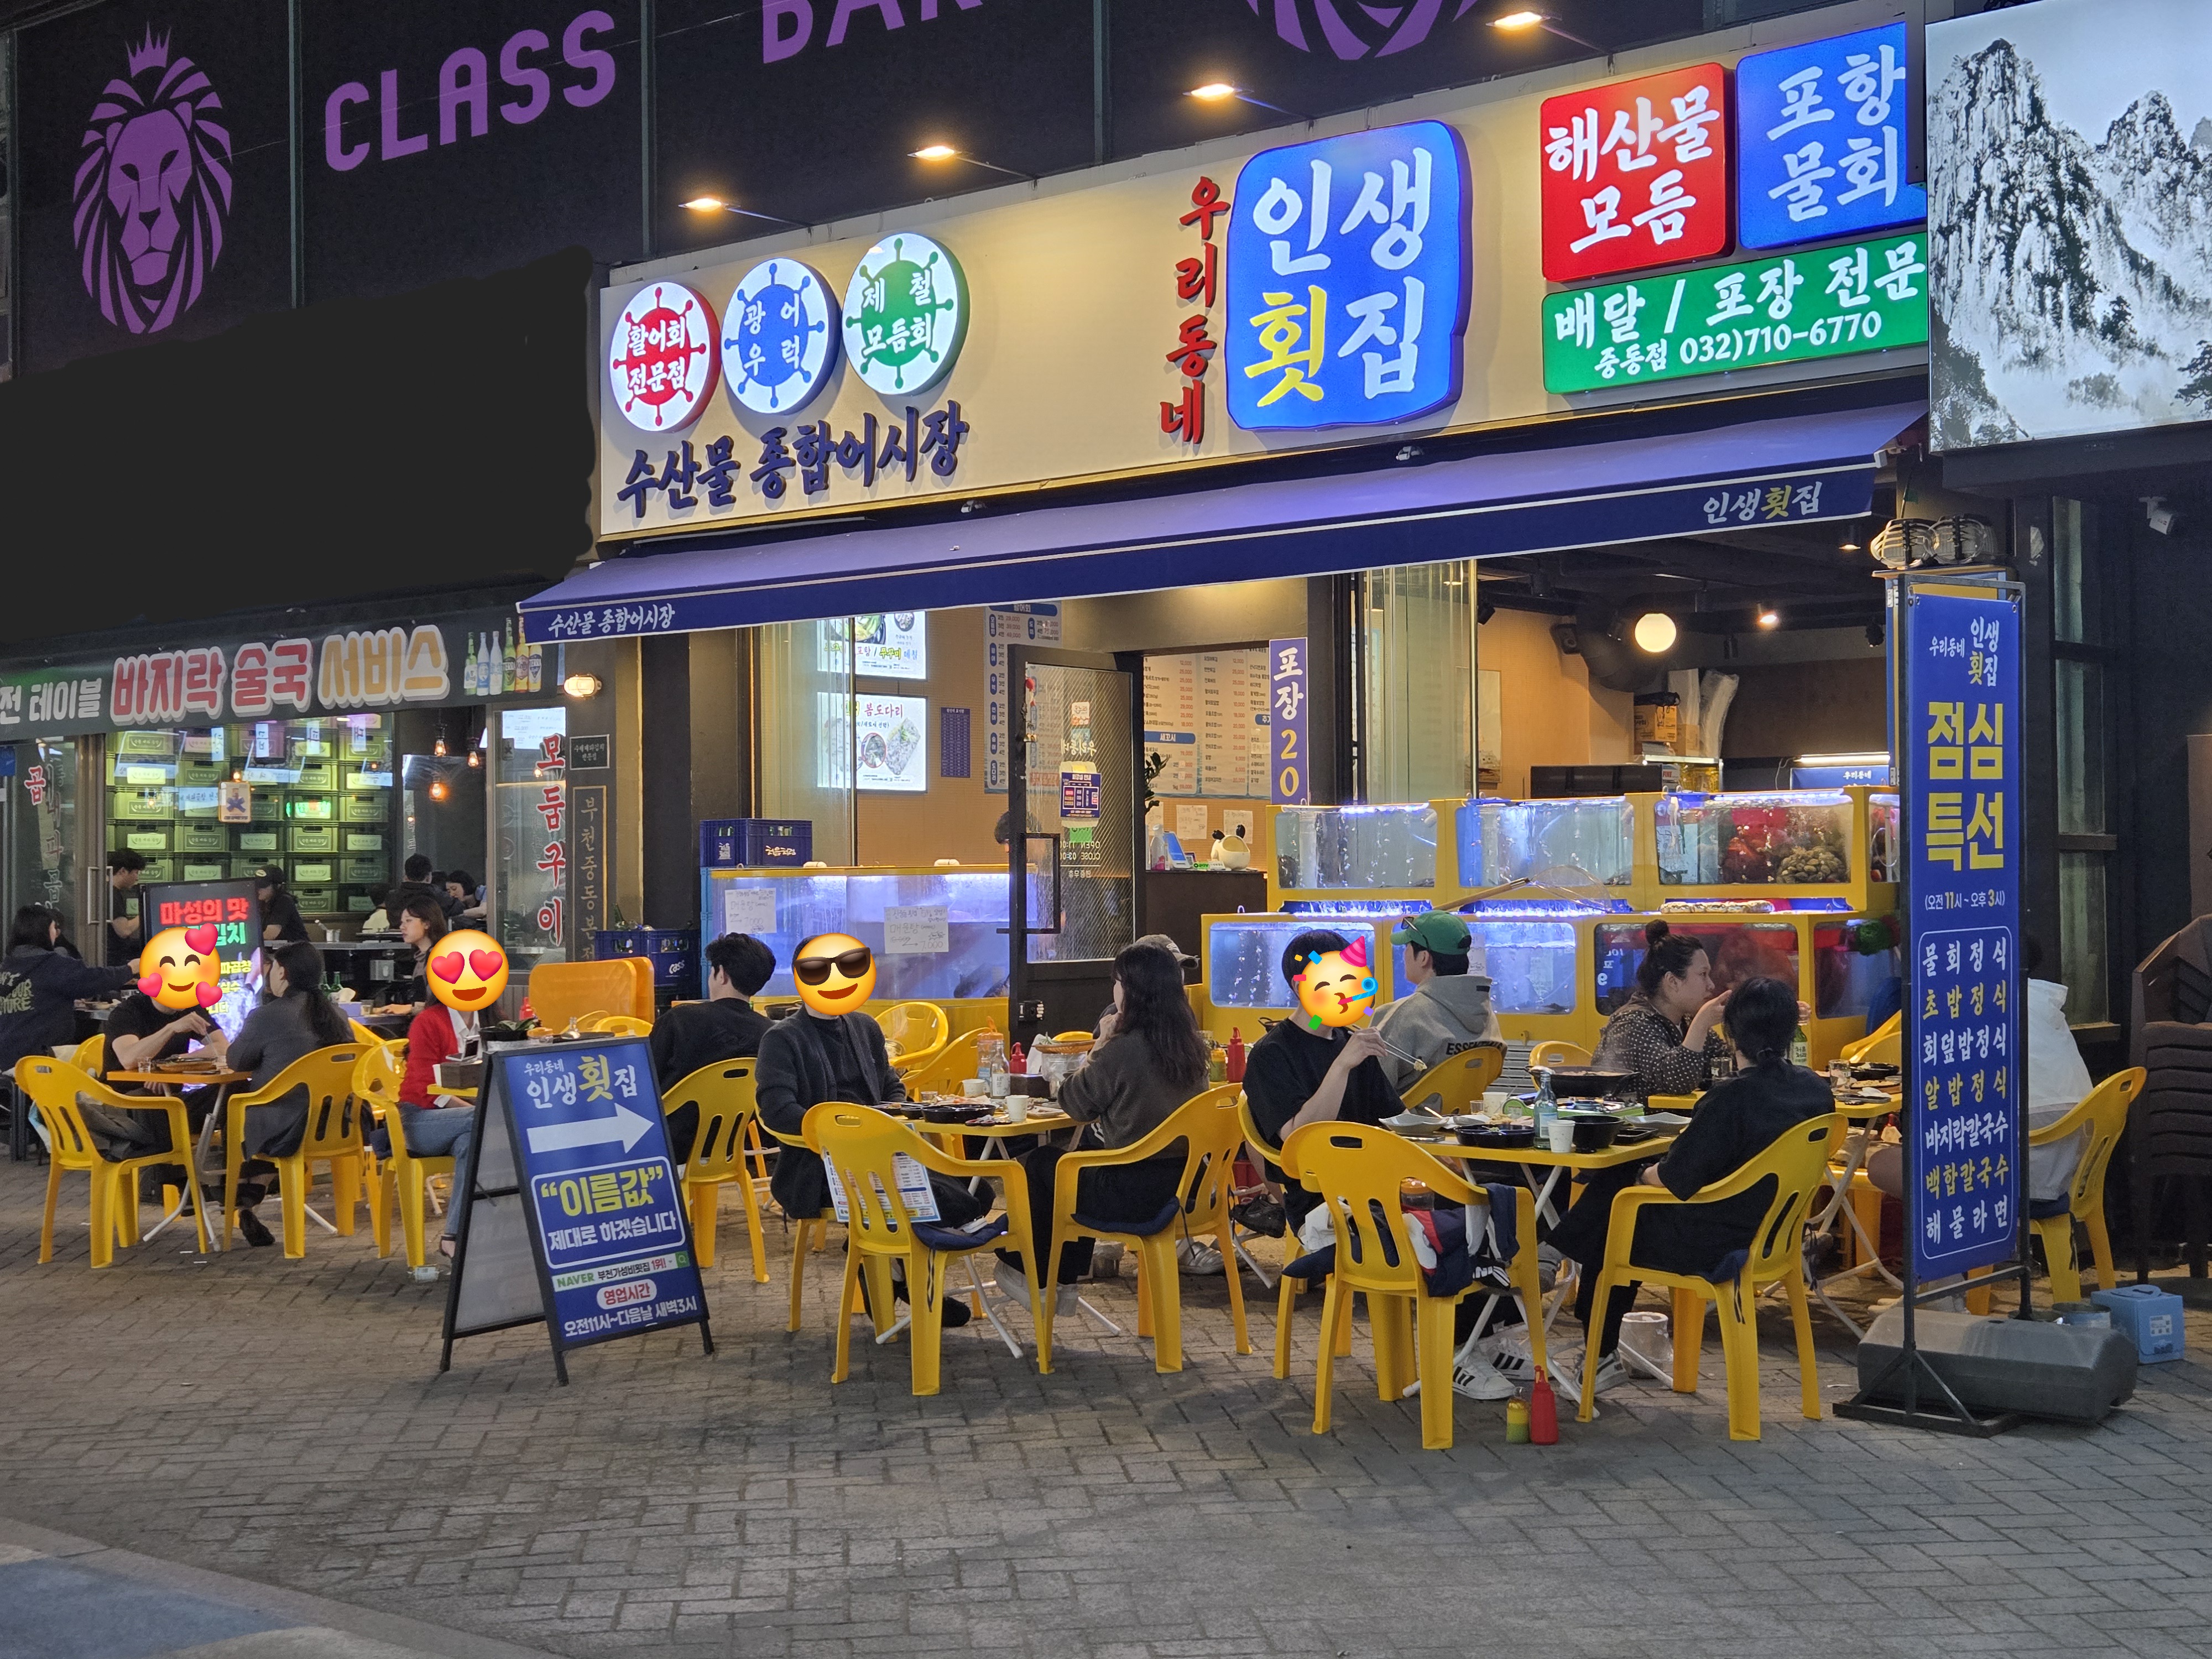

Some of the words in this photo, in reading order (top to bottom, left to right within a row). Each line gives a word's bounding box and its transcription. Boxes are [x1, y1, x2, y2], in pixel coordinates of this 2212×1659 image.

[325, 10, 617, 172] CLASS
[1767, 44, 1906, 142] 포항
[1545, 85, 1720, 182] 해산물
[1767, 126, 1898, 222] 물회
[1253, 147, 1432, 276] 인생
[1160, 176, 1231, 445] 우리동네
[1555, 285, 1645, 350] 배달
[1706, 258, 1804, 327] 포장
[1825, 241, 1927, 309] 전문
[627, 319, 686, 357] 활어회
[1244, 276, 1425, 408] 횟집
[1594, 339, 1668, 379] 중동점
[1680, 310, 1882, 365] 032)710-6770
[628, 358, 686, 395] 전문점
[617, 435, 742, 518] 수산물
[750, 400, 971, 499] 종합어시장
[1703, 481, 1823, 524] 인생횟집
[548, 611, 596, 638] 수산물
[598, 603, 676, 634] 종합어시장
[1970, 615, 2000, 653] 인생
[1929, 635, 1965, 659] 우리동네
[1967, 649, 1999, 687] 횟집
[29, 677, 102, 722] 테이블
[112, 649, 225, 721] 바지락
[233, 640, 310, 711] 술국
[320, 628, 447, 703] 서비스
[1274, 646, 1304, 720] 포장
[1927, 701, 2004, 780] 점심
[1279, 728, 1298, 805] 20
[1843, 770, 1872, 780] 우리동네
[765, 844, 797, 857] 처음처럼
[1926, 791, 2004, 872] 특선
[160, 899, 223, 925] 마성의
[226, 897, 250, 922] 맛
[220, 960, 252, 974] 파곱창
[524, 1058, 565, 1076] 우리동네
[1922, 1022, 2007, 1067] 회덮밥정식
[526, 1054, 638, 1109] 인생횟집
[1925, 1110, 2008, 1156] 바지락칼국수
[1926, 1153, 2009, 1201] 백합칼국수
[548, 1223, 599, 1251] 제대로
[599, 1210, 677, 1243] 하겠습니다
[556, 1272, 595, 1288] NAVER
[603, 1282, 651, 1306] 영업시간
